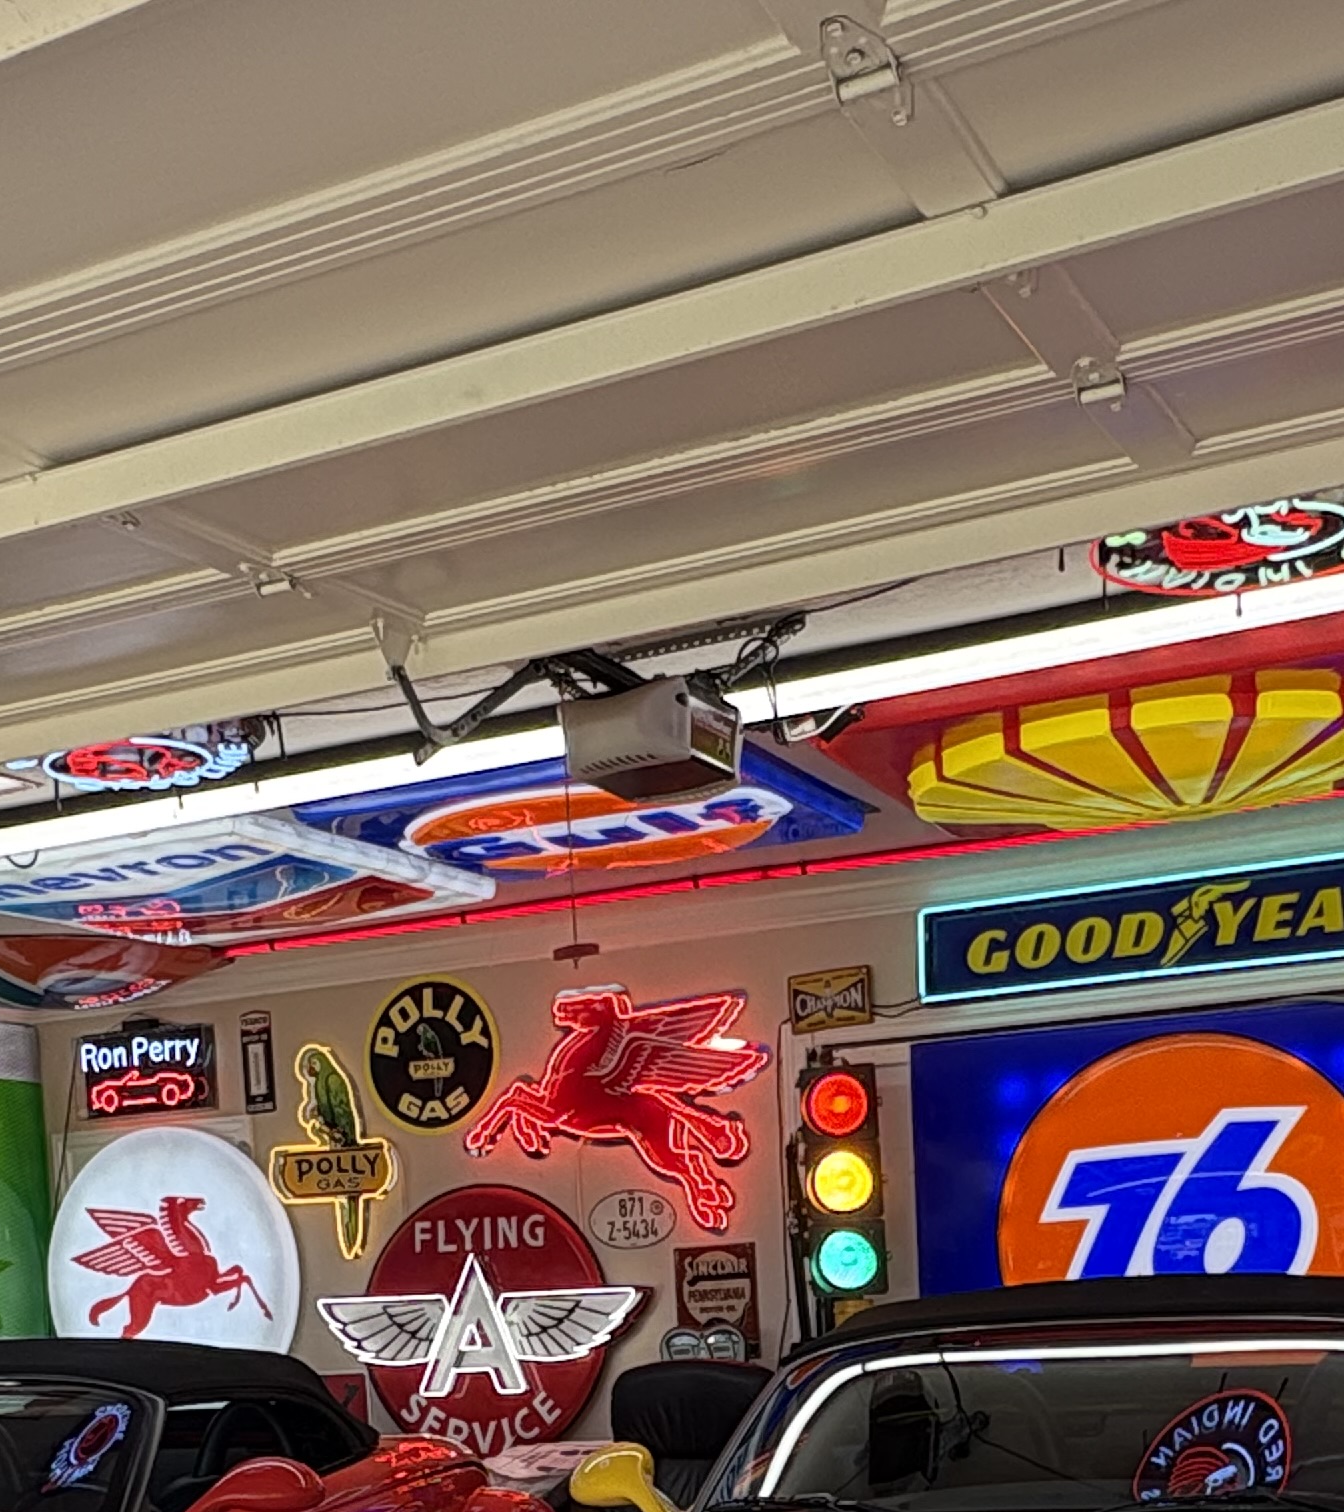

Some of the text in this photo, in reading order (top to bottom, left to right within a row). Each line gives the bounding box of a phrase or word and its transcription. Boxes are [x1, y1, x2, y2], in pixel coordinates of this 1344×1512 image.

[374, 987, 489, 1059] POLLY
[80, 1036, 200, 1074] Ron Perry
[412, 1061, 451, 1074] POLLY
[396, 1085, 471, 1122] GAS
[294, 1151, 381, 1184] POLLY
[316, 1176, 361, 1190] GAS
[617, 1196, 645, 1218] 871
[1040, 1105, 1320, 1280] 76
[413, 1213, 546, 1254] FLYING
[606, 1217, 659, 1242] Z-5434
[420, 1253, 526, 1398] A
[399, 1389, 563, 1457] SERVICE
